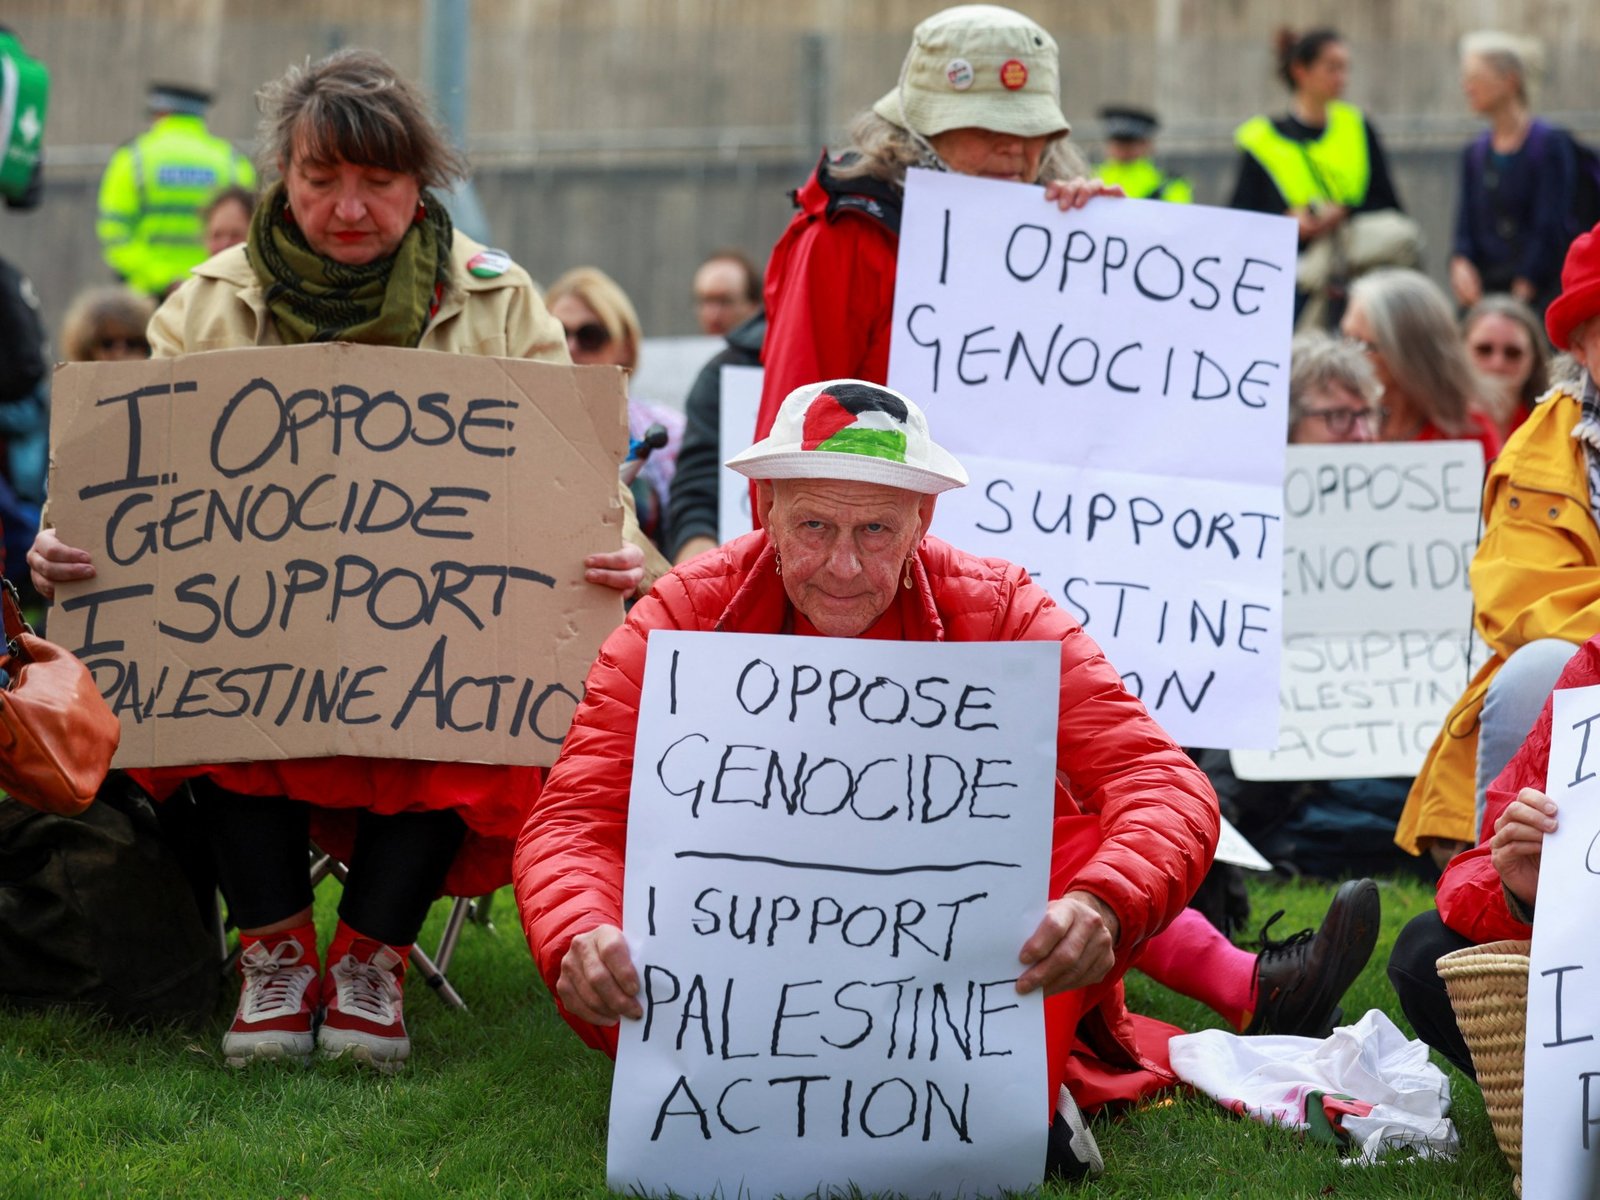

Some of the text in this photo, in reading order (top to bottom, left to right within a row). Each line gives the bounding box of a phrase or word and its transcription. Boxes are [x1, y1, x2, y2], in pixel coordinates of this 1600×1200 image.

[939, 209, 1282, 316] I OPPOSE
[906, 303, 1280, 408] GENOCIDE
[79, 377, 519, 500] I OPPOSE
[106, 473, 491, 566] GENOCIDE
[976, 478, 1280, 560] SUPPORT
[1283, 461, 1477, 518] OPPOSE
[60, 554, 556, 659] I SUPPORT
[1029, 571, 1271, 654] STINE
[391, 634, 587, 745] ACTIO
[669, 649, 999, 731] I OPPOSE
[656, 732, 1019, 824] GENOCIDE
[648, 886, 988, 962] I SUPPORT
[641, 964, 1020, 1061] PALESTINE
[1541, 965, 1594, 1048] I
[650, 1075, 974, 1145] ACTION
